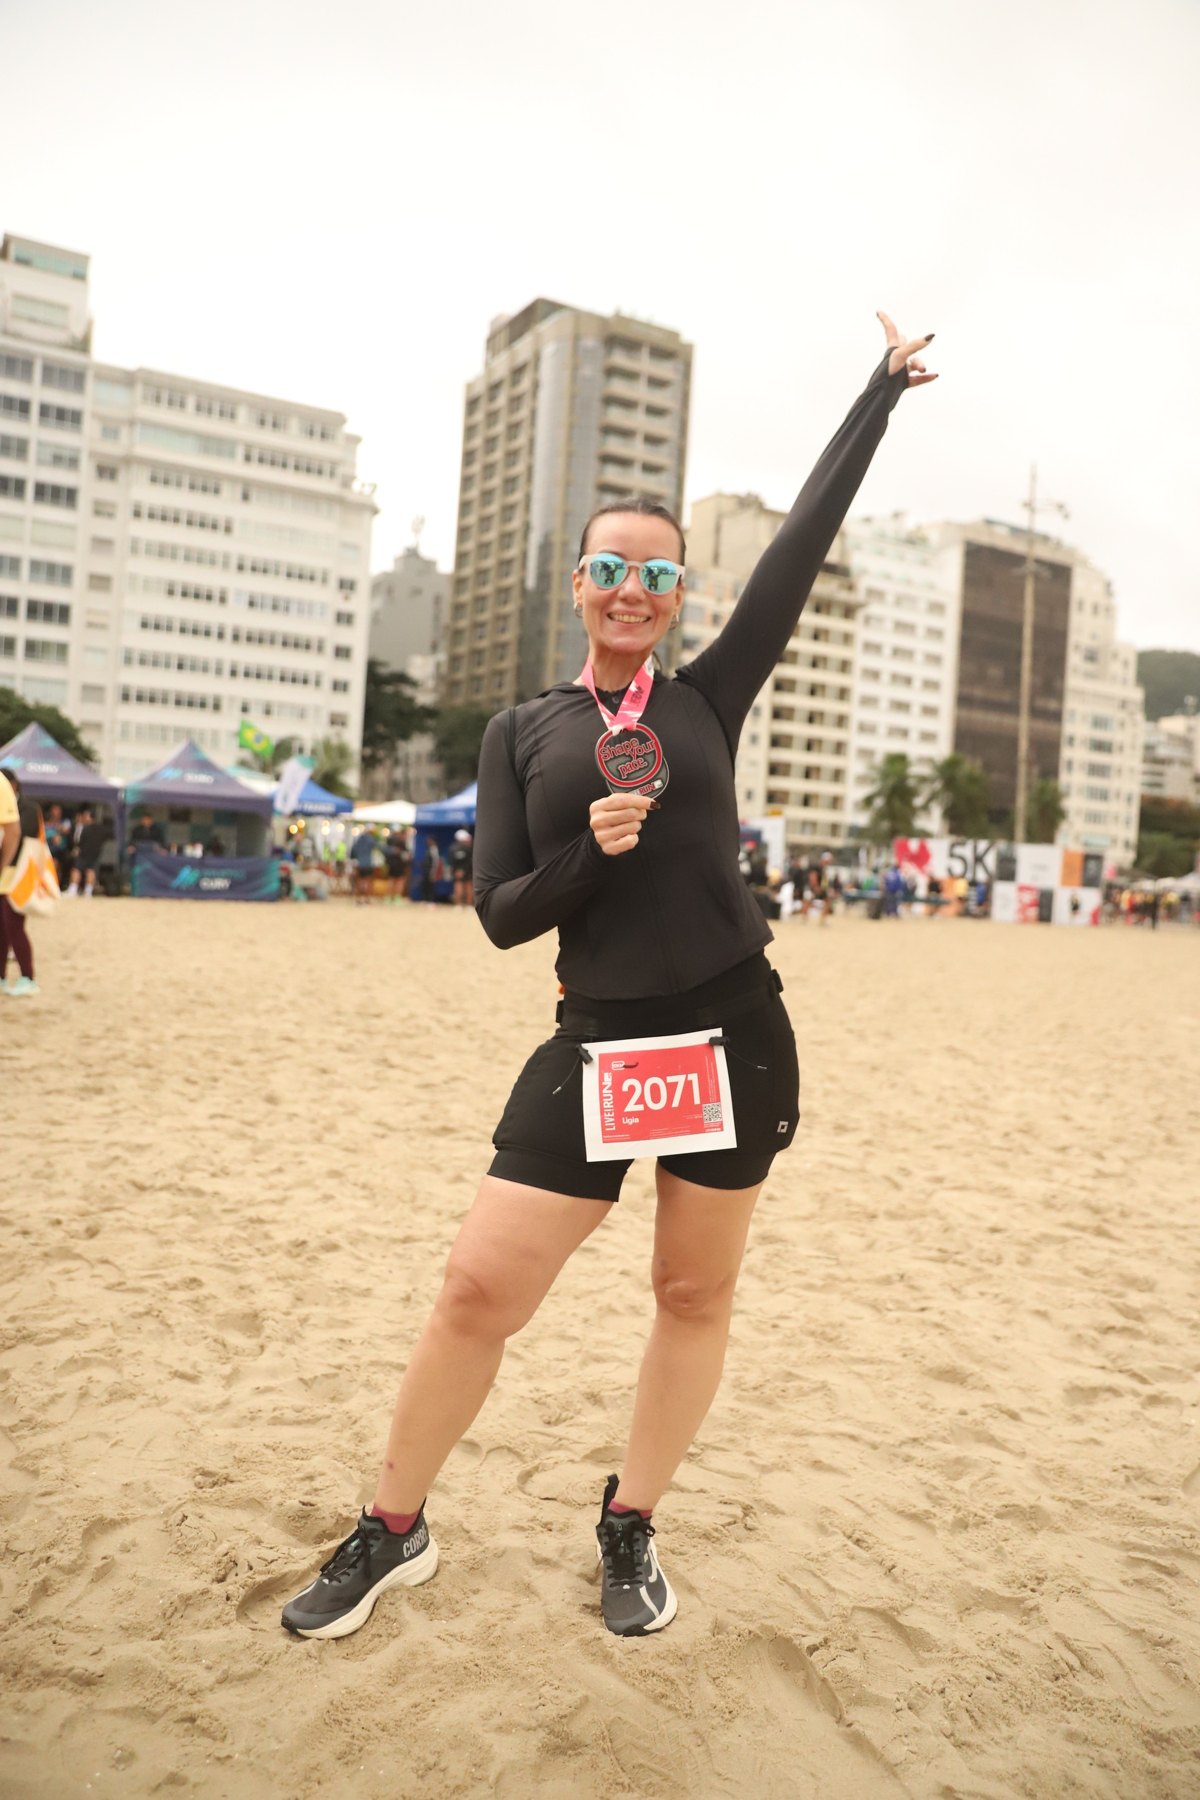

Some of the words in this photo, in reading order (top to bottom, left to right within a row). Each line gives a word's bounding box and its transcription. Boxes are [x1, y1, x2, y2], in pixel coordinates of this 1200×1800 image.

[600, 738, 638, 760] Shape
[629, 740, 655, 760] your
[947, 840, 996, 880] 5K
[622, 1073, 701, 1112] 2071
